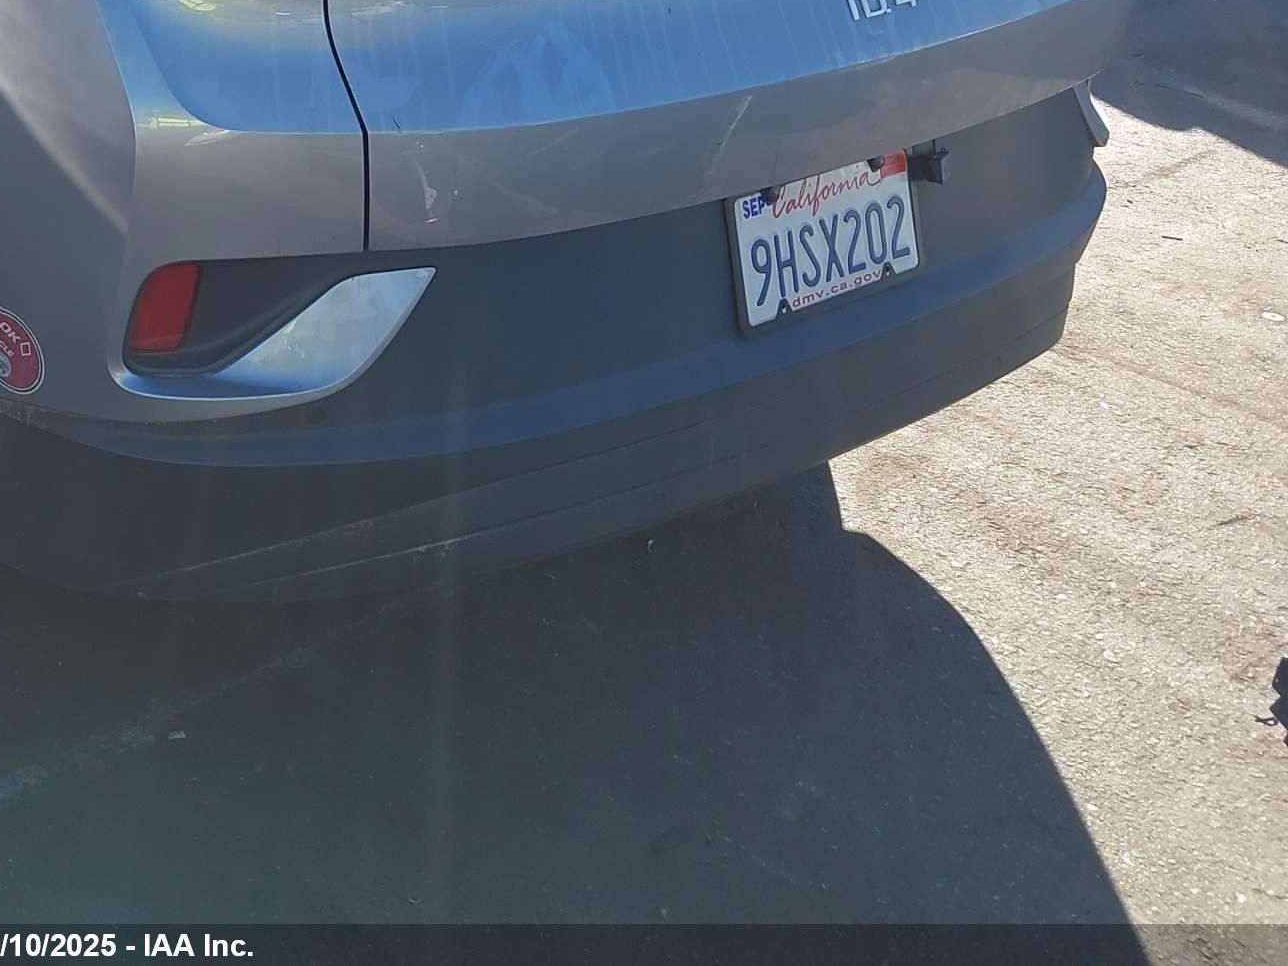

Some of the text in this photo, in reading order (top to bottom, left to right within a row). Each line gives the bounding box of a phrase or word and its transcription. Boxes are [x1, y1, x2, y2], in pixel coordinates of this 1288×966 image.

[772, 165, 882, 219] California
[750, 194, 911, 307] 9HSX202
[792, 268, 882, 309] dmv.ca.gov
[0, 321, 22, 344] OK
